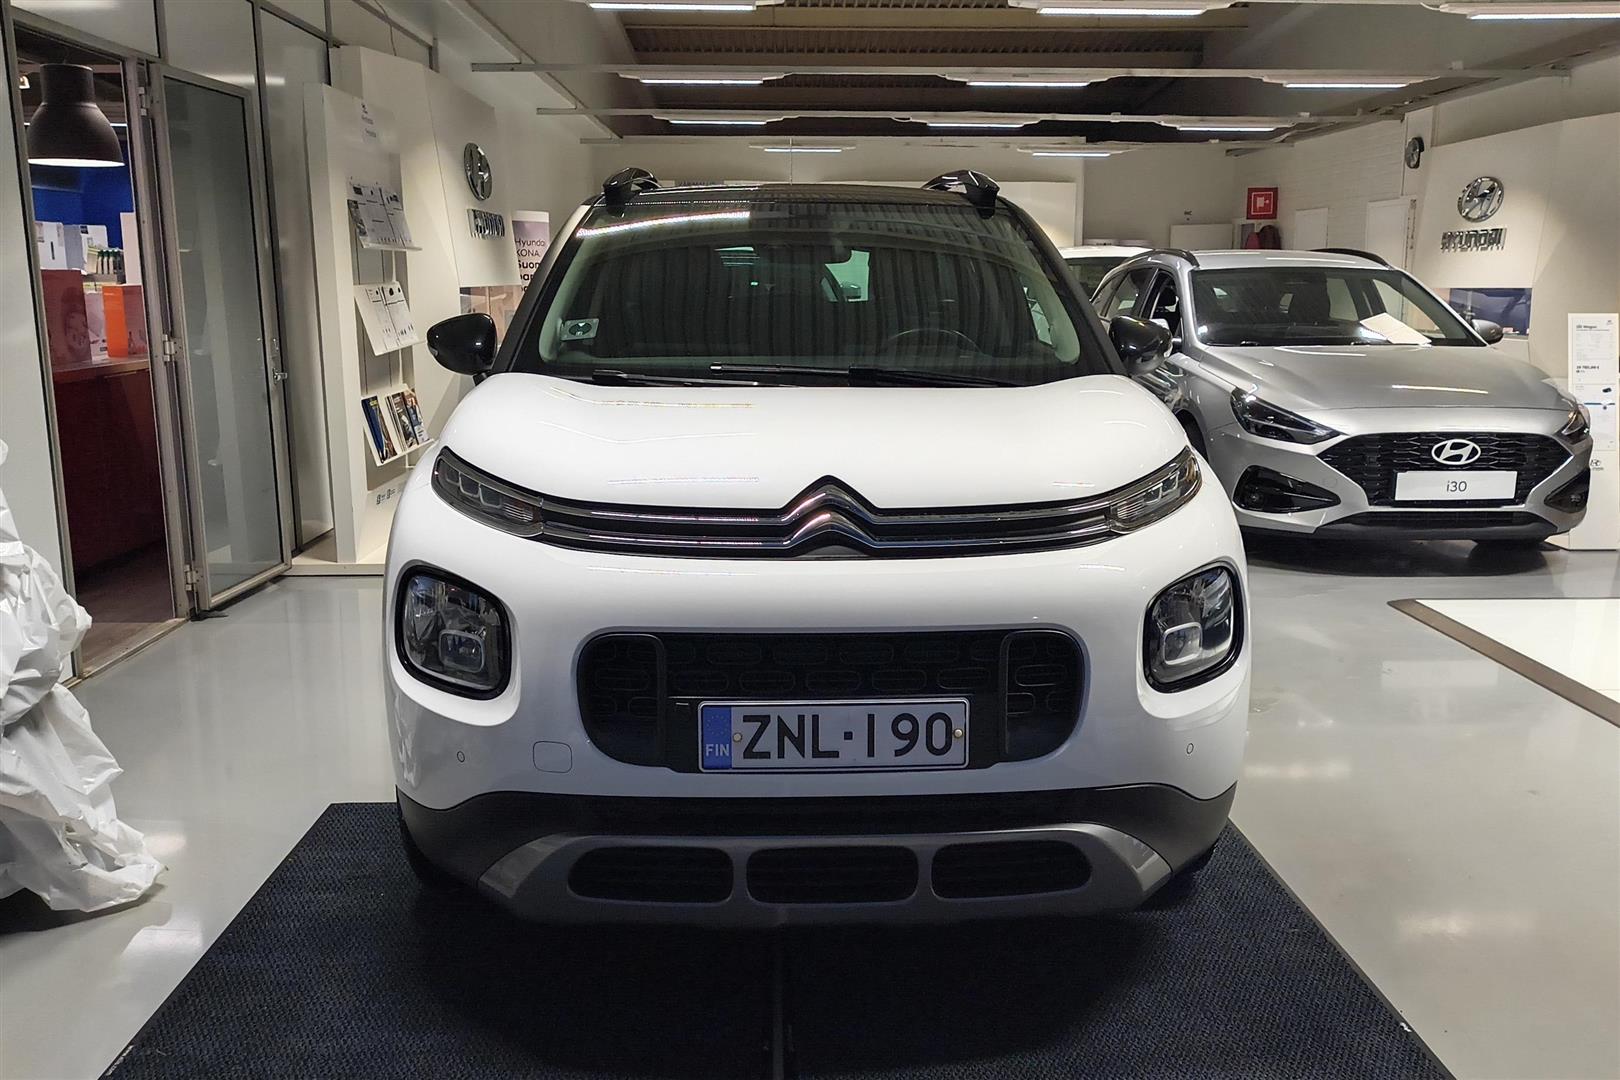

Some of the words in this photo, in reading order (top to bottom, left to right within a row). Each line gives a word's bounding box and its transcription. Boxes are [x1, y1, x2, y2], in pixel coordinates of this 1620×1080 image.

[1441, 228, 1507, 250] HYUNDAI
[1446, 480, 1467, 493] i30
[705, 744, 730, 757] FIN
